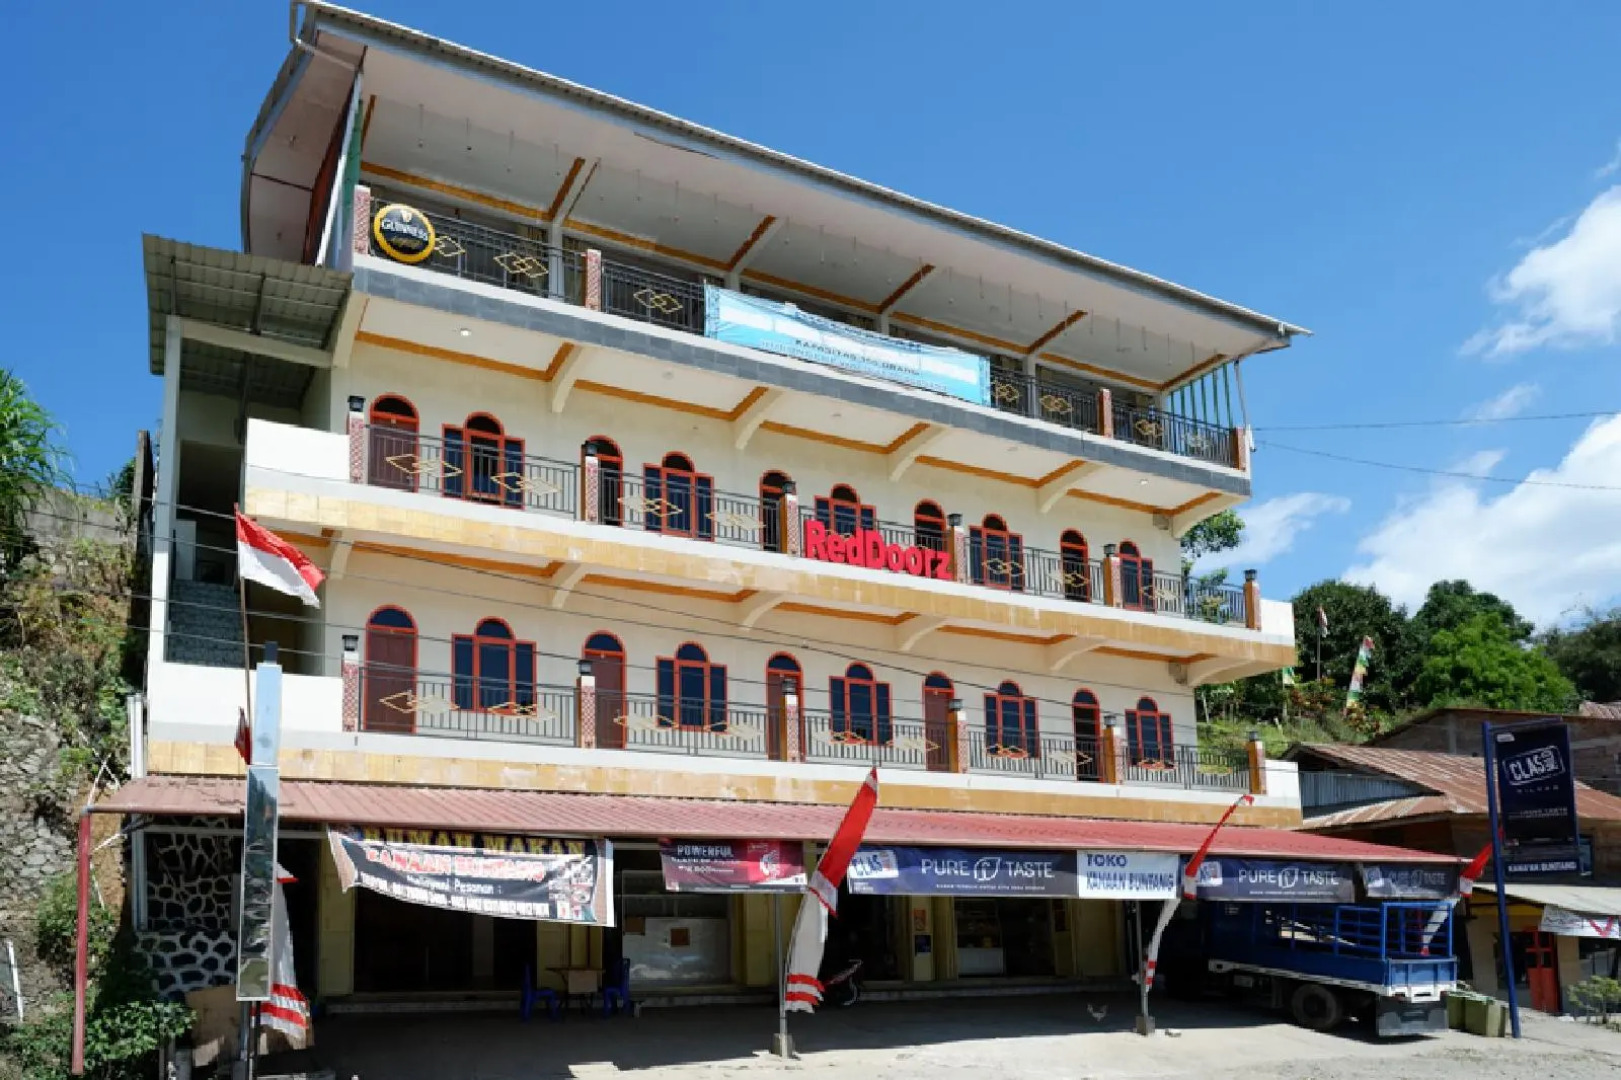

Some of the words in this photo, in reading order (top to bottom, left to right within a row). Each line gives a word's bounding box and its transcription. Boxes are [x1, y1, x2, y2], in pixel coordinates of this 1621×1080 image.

[804, 519, 953, 581] RedDoorz
[921, 858, 970, 876] PURE
[1006, 860, 1055, 878] TASTE
[1087, 853, 1128, 867] TOKO
[1238, 869, 1277, 884] PURE
[1302, 870, 1339, 885] TASTE
